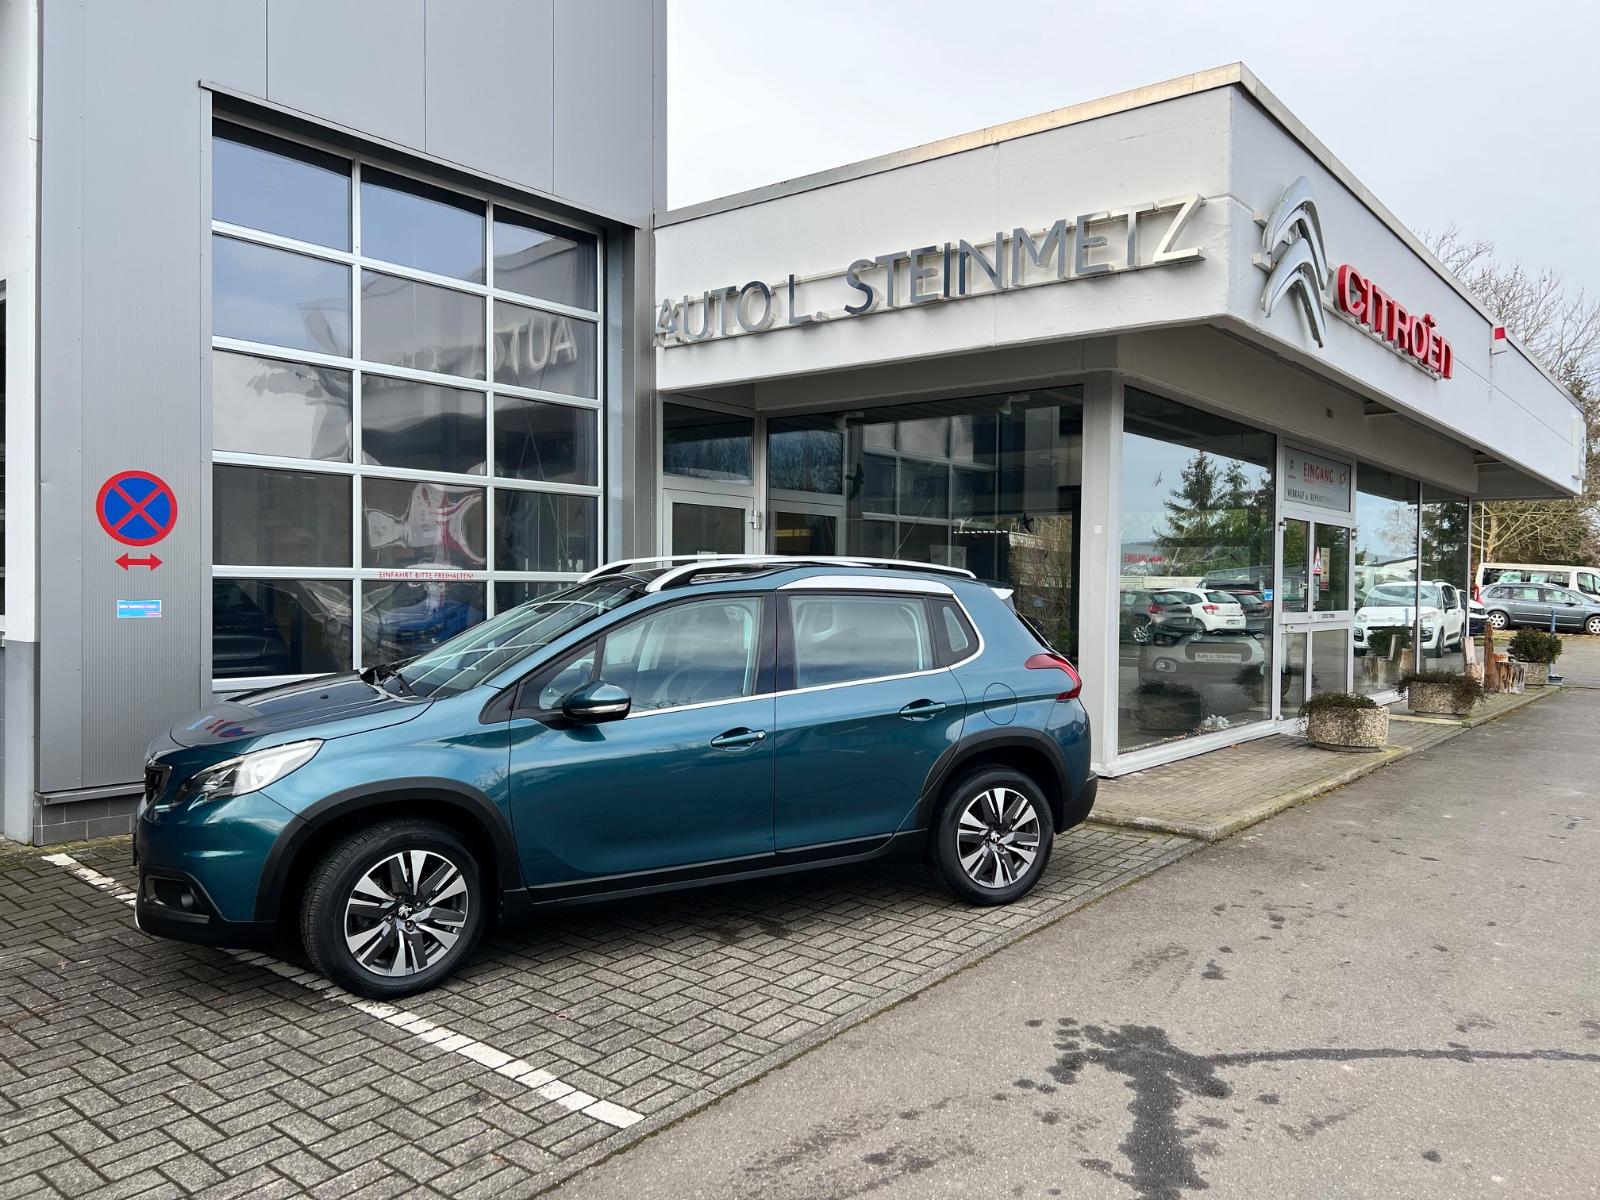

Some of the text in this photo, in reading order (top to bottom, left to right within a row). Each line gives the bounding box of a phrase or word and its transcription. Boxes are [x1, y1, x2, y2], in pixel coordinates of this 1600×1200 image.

[655, 280, 774, 342] AUTO
[844, 193, 1206, 315] STEINMETZ
[1303, 462, 1334, 483] EINGANG
